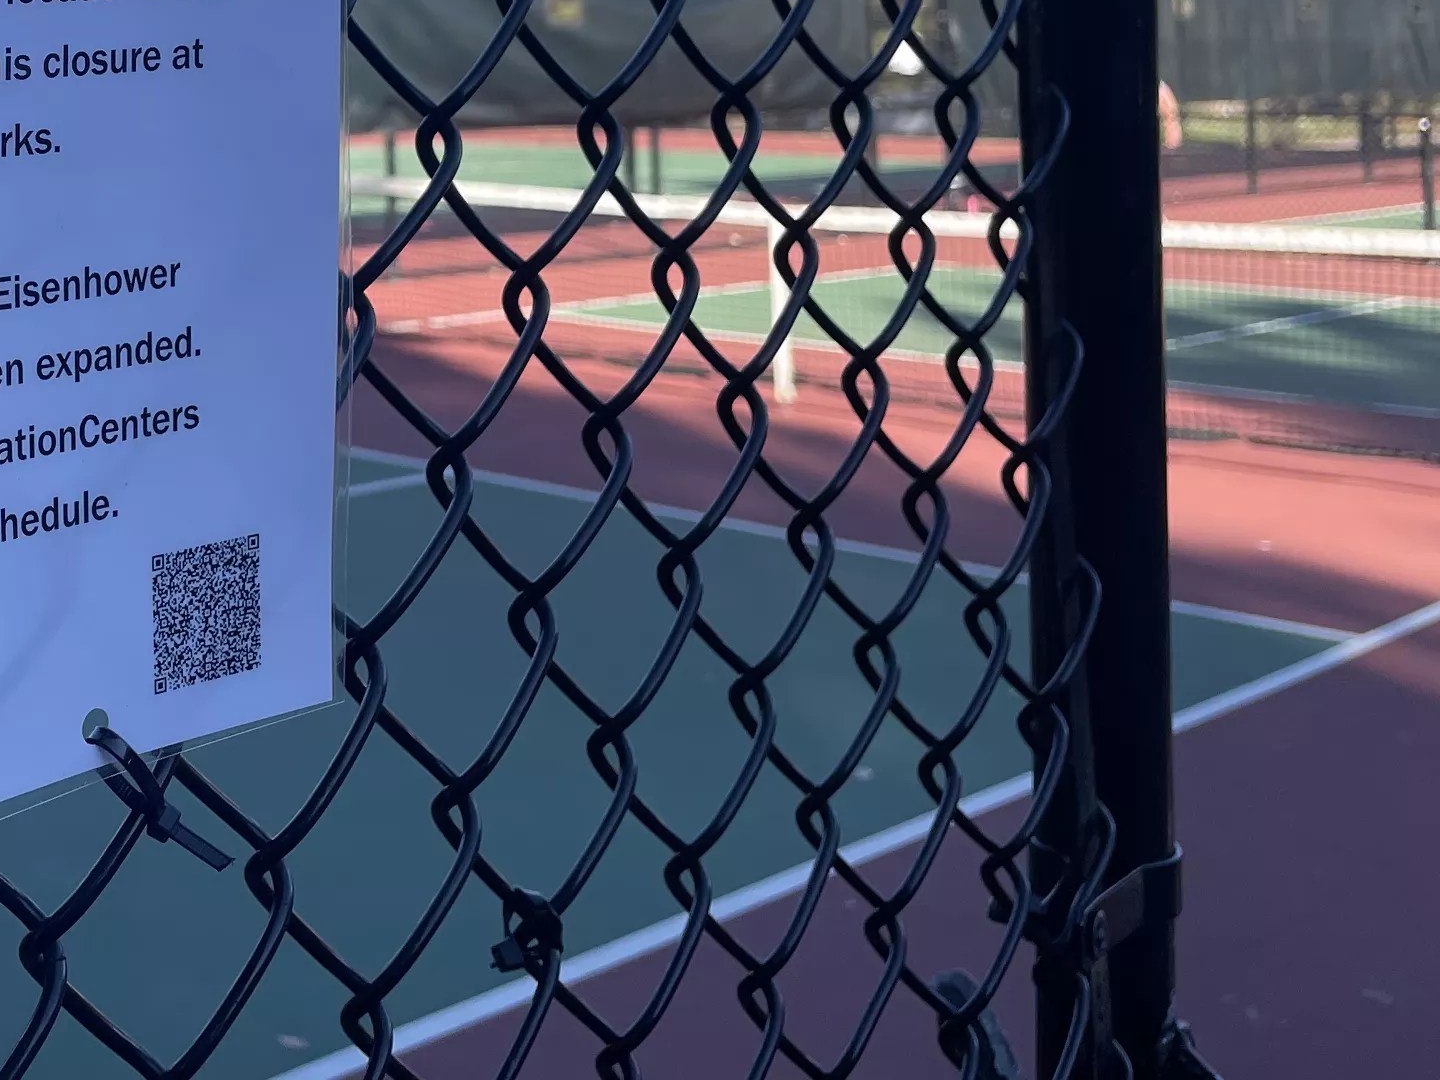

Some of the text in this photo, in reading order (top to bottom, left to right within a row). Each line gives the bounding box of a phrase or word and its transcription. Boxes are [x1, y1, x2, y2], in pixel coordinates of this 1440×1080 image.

[44, 44, 161, 78] closure
[172, 39, 203, 70] at
[37, 326, 202, 383] expanded.
